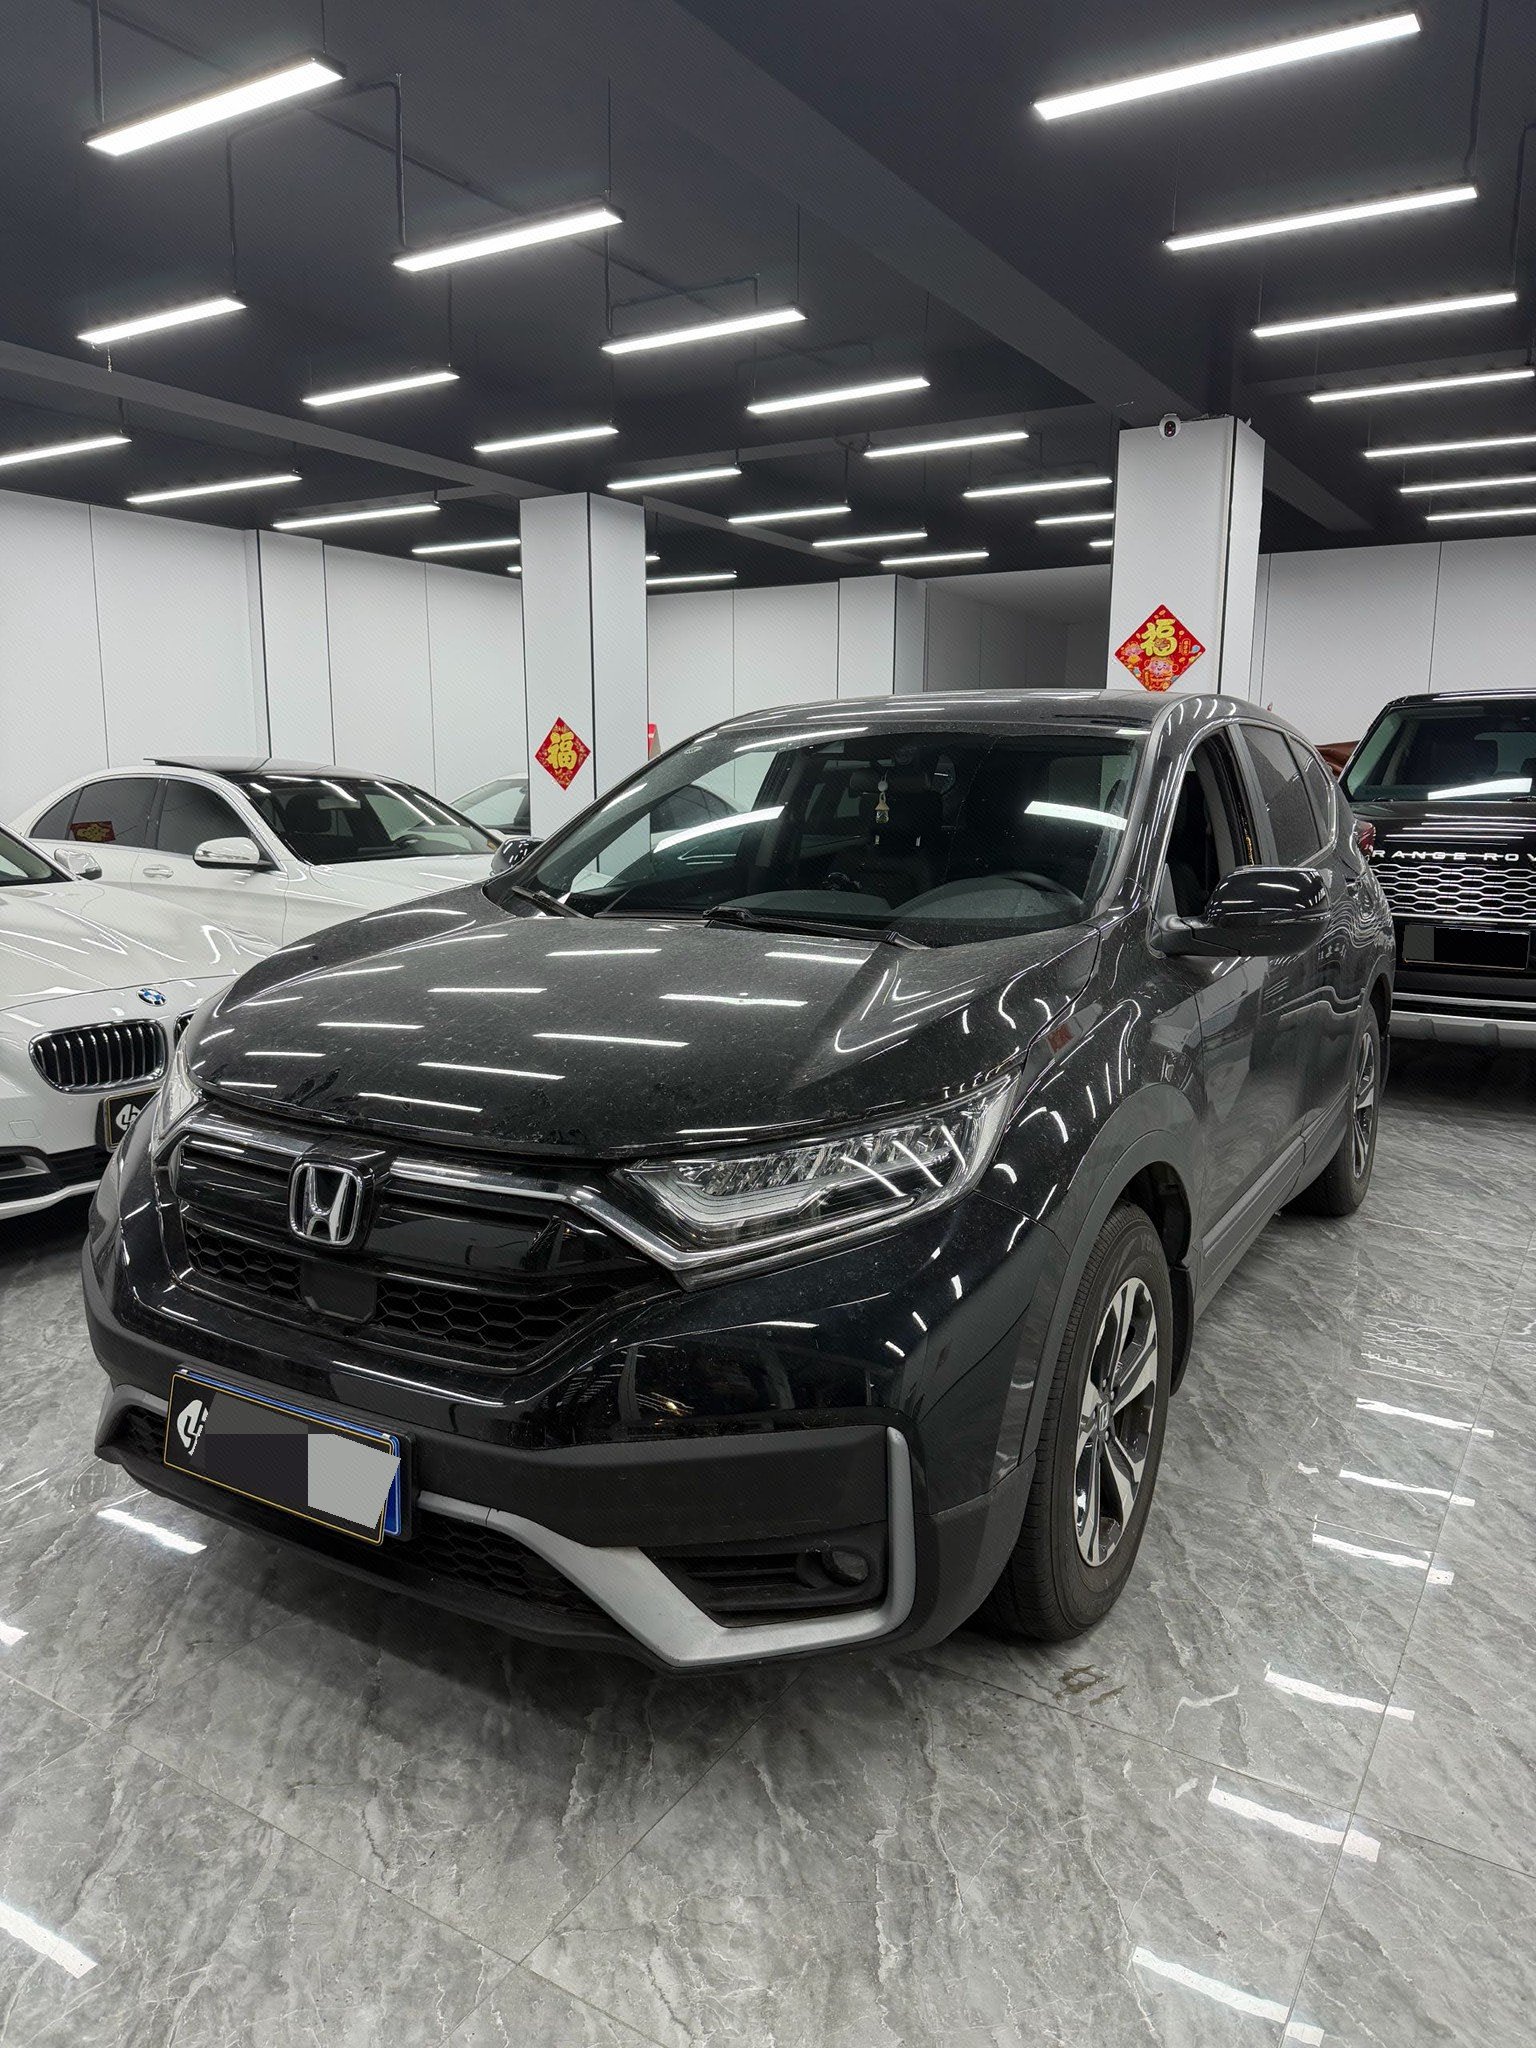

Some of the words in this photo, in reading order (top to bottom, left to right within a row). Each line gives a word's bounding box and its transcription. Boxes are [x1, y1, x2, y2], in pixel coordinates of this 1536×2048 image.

[1140, 619, 1178, 657] 福
[546, 731, 578, 770] 福
[1371, 849, 1467, 861] RANGE
